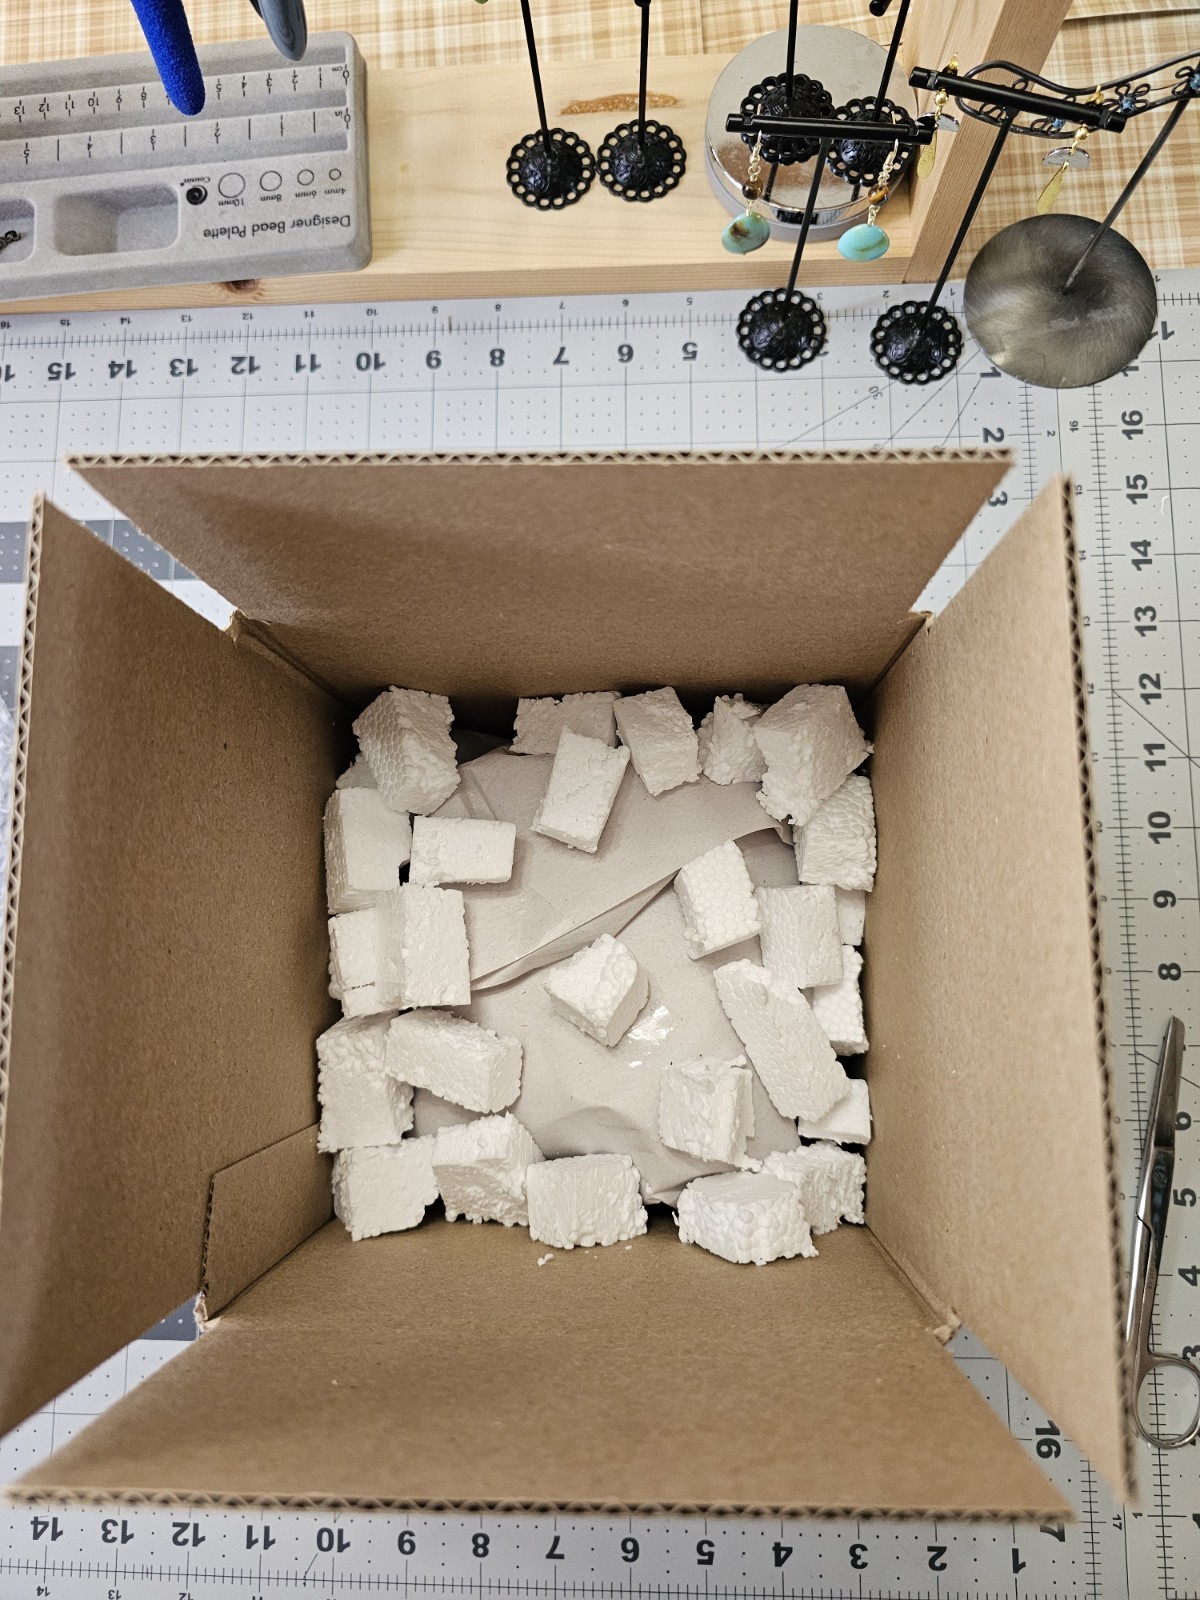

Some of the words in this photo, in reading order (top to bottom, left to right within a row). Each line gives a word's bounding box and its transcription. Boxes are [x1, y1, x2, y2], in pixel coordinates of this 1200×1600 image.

[13, 106, 25, 115] 13
[38, 102, 50, 112] 12
[65, 100, 75, 109] 11
[87, 97, 100, 107] 10
[335, 110, 343, 118] in
[260, 193, 282, 202] 8mm
[295, 190, 317, 198] 6mm
[324, 187, 346, 195] 4mm
[218, 198, 244, 207] 10mm
[252, 221, 286, 237] Bead
[290, 214, 351, 228] Designer
[203, 225, 246, 239] Palette
[622, 299, 629, 307] 6
[686, 297, 693, 306] 5
[816, 292, 823, 301] 3
[882, 290, 890, 298] 2
[304, 310, 316, 319] 11
[366, 308, 379, 317] 10
[431, 306, 439, 314] 9
[495, 303, 502, 312] 8
[559, 301, 566, 310] 7
[60, 319, 72, 327] 15
[120, 317, 132, 325] 14
[181, 314, 194, 323] 13
[242, 312, 254, 321] 12
[425, 350, 442, 369] 9
[490, 348, 505, 368] 8
[553, 346, 570, 366] 7
[617, 344, 634, 363] 6
[682, 342, 698, 361] 5
[108, 360, 138, 379] 14
[169, 358, 199, 378] 13
[231, 356, 261, 375] 12
[295, 354, 321, 374] 11
[356, 352, 387, 371] 10
[0, 364, 16, 382] 1
[47, 362, 76, 381] 15
[980, 366, 1002, 378] 1
[982, 427, 1005, 443] 2
[1047, 430, 1056, 438] 2
[1069, 420, 1079, 433] 16
[1121, 410, 1144, 441] 16
[1126, 474, 1148, 505] 15
[988, 491, 1008, 508] 3
[1130, 539, 1153, 572] 14
[1134, 605, 1157, 638] 13
[1138, 672, 1162, 706] 12
[1143, 743, 1167, 772] 11
[1147, 811, 1172, 845] 10
[1153, 890, 1177, 909] 9
[1157, 962, 1182, 981] 8
[1173, 1187, 1197, 1208] 5
[1178, 1265, 1200, 1287] 4
[1035, 1419, 1062, 1459] 16
[30, 1516, 64, 1542] 14
[101, 1518, 135, 1545] 13
[1112, 1513, 1123, 1531] 17
[171, 1521, 206, 1548] 12
[245, 1524, 276, 1551] 11
[316, 1527, 351, 1553] 10
[397, 1530, 416, 1555] 9
[471, 1532, 491, 1558] 8
[545, 1535, 565, 1560] 7
[620, 1537, 640, 1563] 6
[696, 1539, 716, 1566] 5
[772, 1541, 793, 1568] 4
[848, 1543, 869, 1570] 3
[926, 1545, 948, 1572] 2
[1011, 1547, 1027, 1574] 1
[36, 1586, 51, 1597] 14
[108, 1589, 122, 1600] 13
